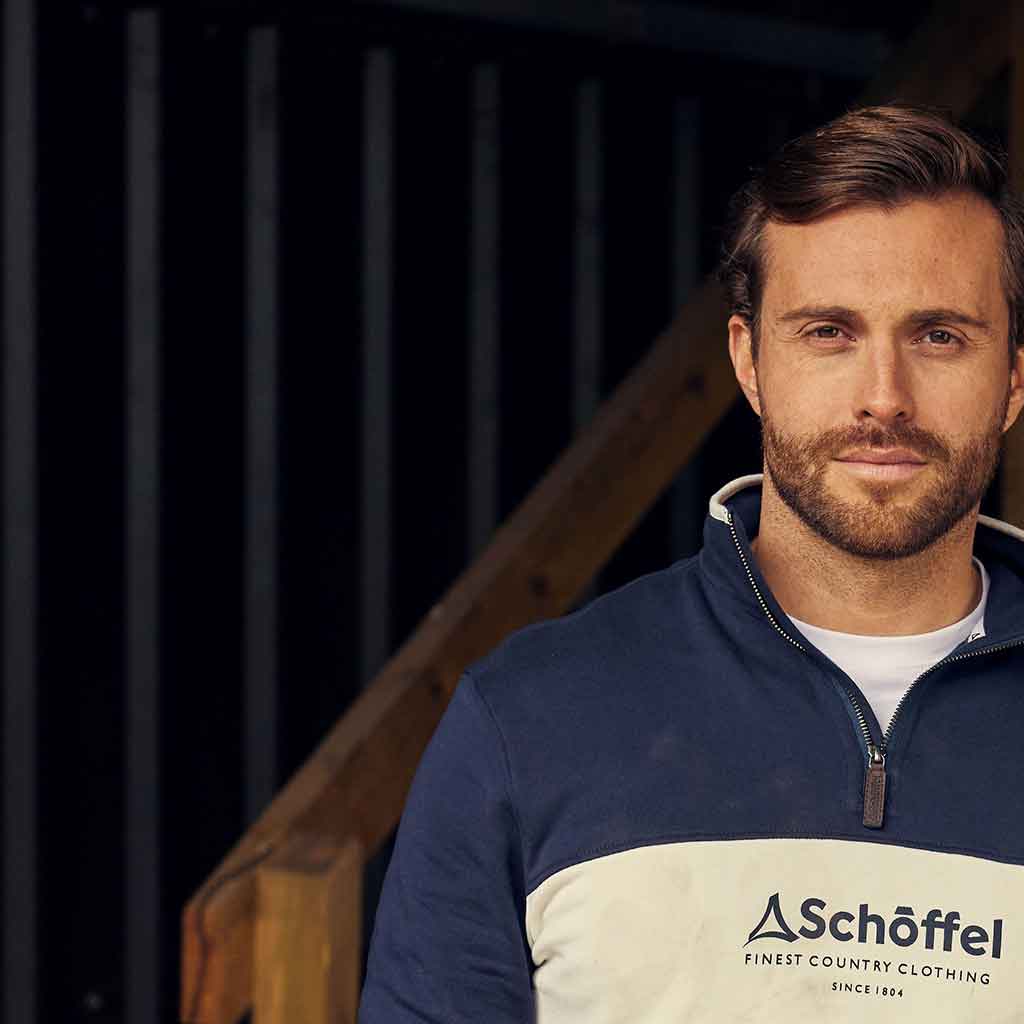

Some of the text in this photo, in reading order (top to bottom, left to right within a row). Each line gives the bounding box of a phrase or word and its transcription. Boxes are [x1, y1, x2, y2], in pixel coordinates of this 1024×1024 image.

[745, 953, 991, 985] FINEST COUNTRY CLOTHING
[831, 982, 904, 998] SINCE 1804
